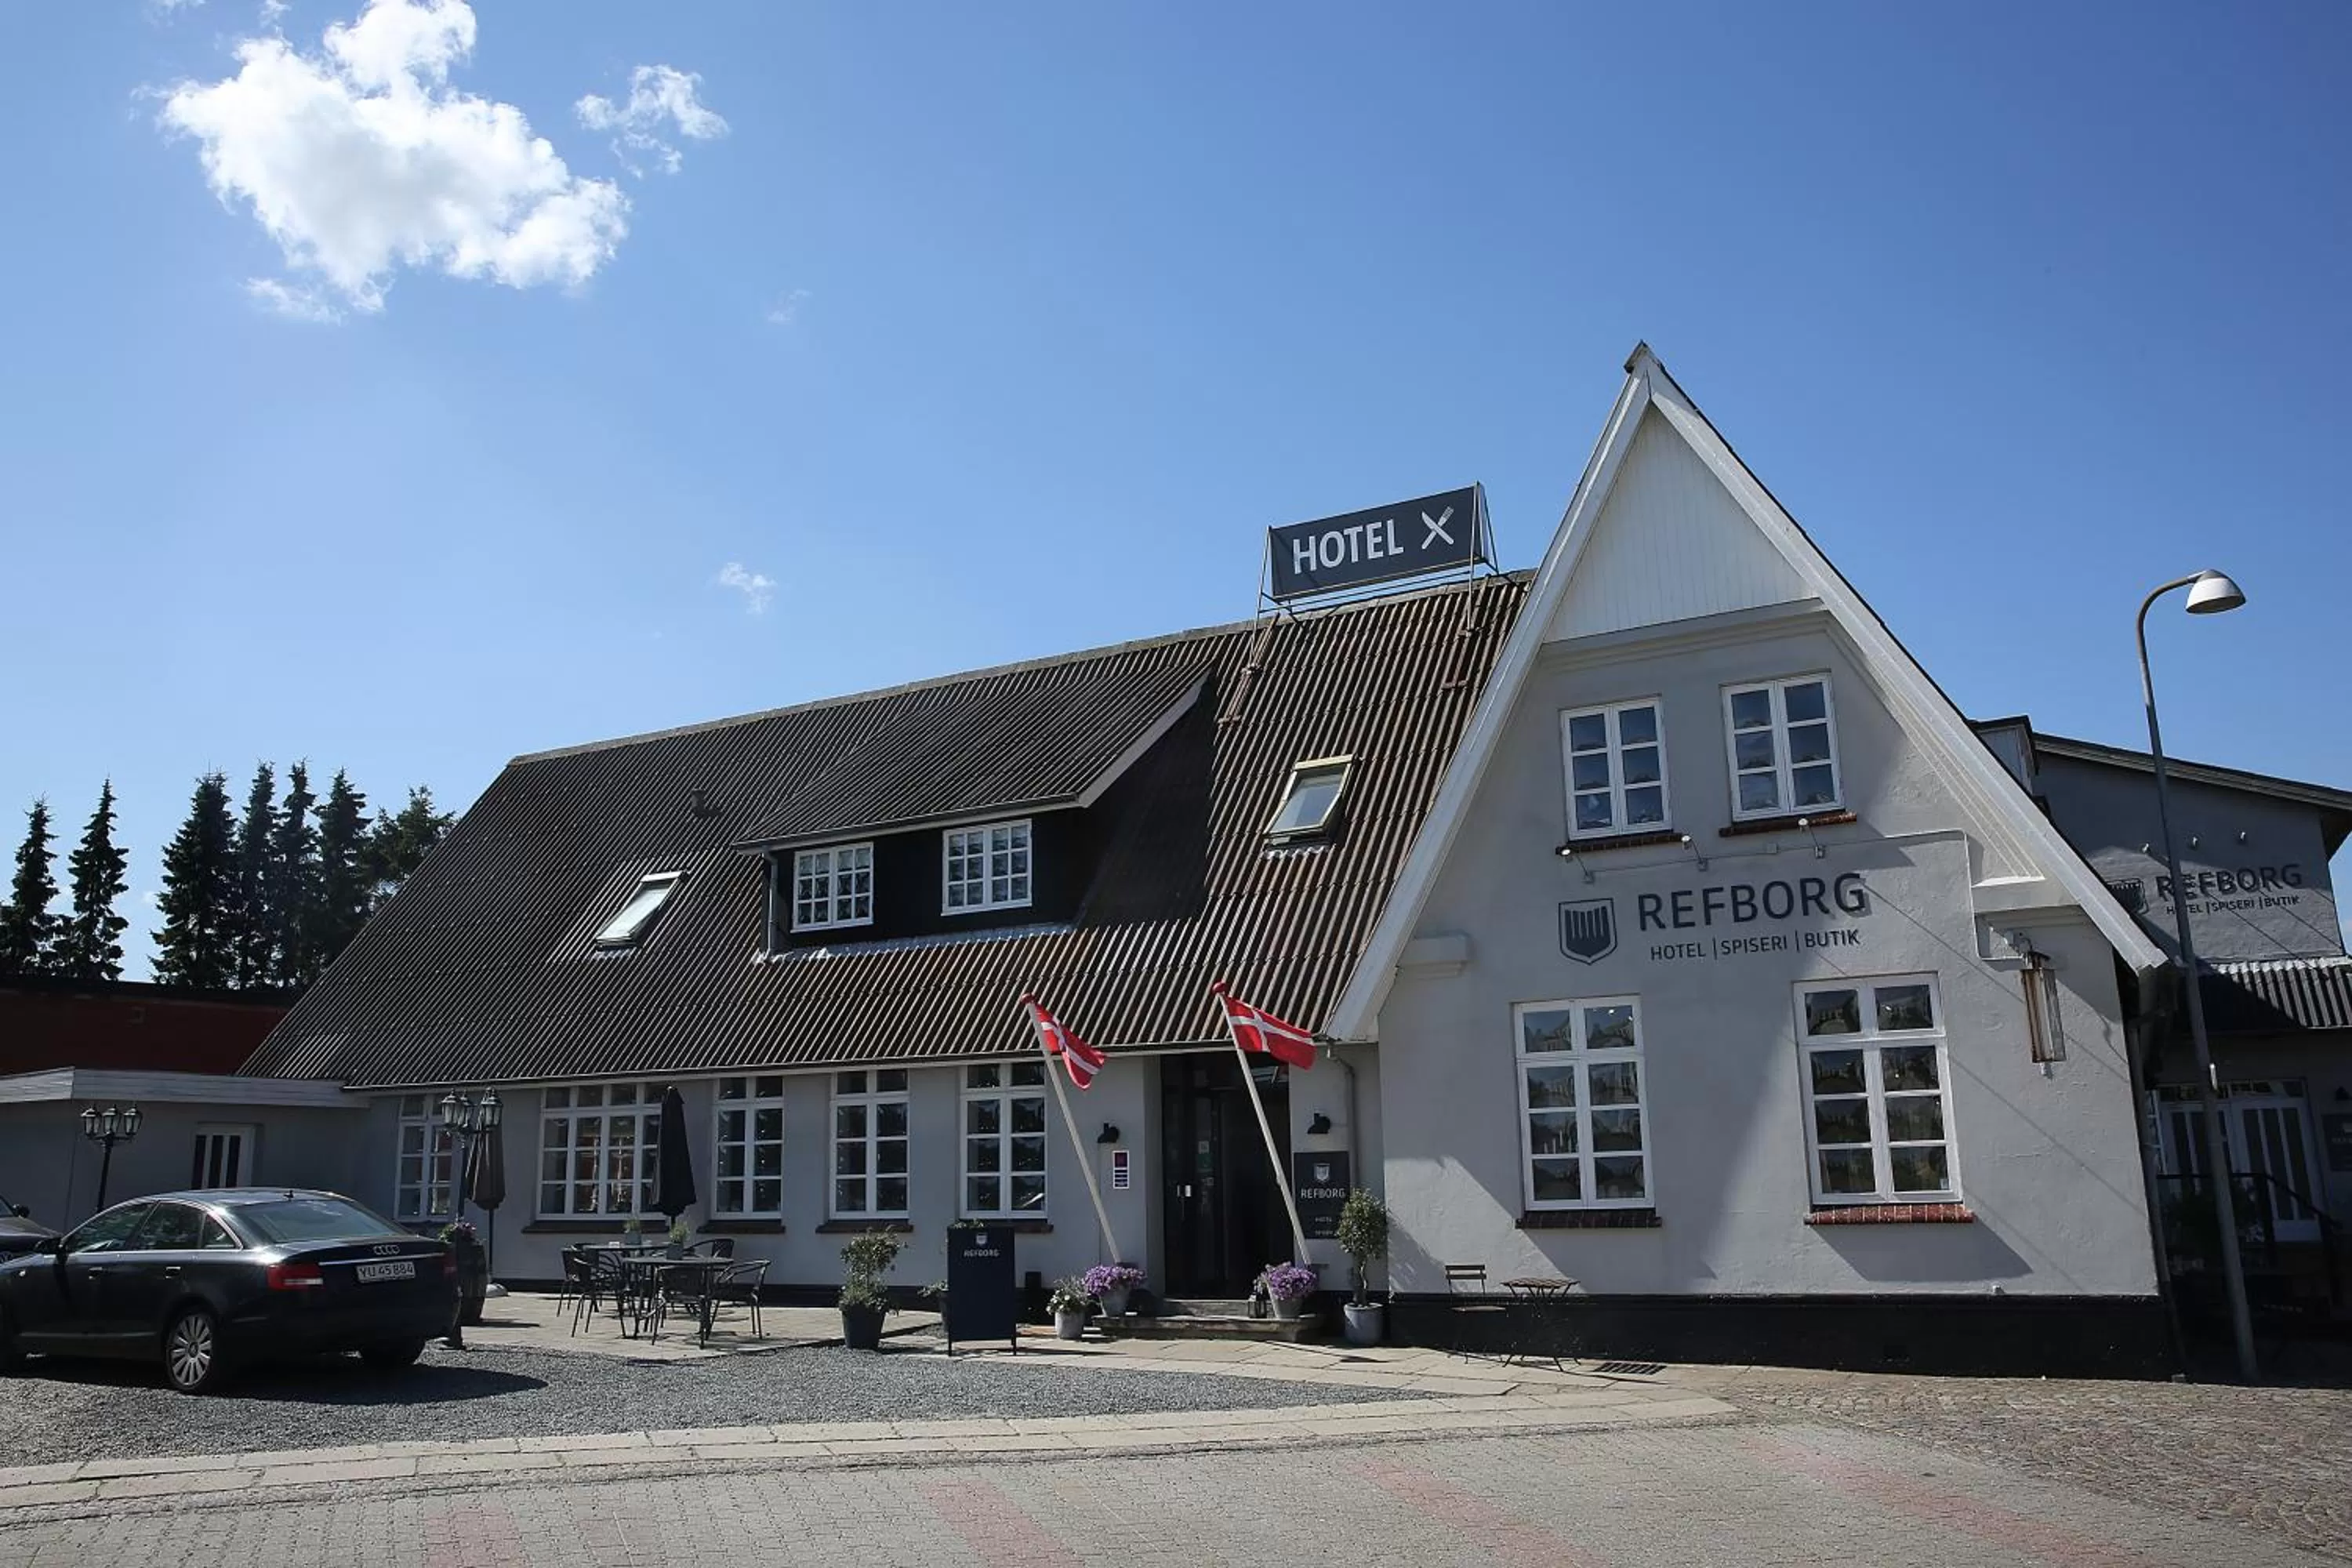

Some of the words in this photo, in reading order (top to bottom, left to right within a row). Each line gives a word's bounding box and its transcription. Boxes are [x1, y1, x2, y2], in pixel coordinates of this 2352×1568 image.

[1294, 518, 1404, 575] HOTEL
[2156, 864, 2302, 901] REFBORG
[1639, 873, 1866, 931] REFBORG
[2166, 905, 2203, 915] HEL
[2212, 899, 2256, 912] SPISERI
[2266, 895, 2299, 907] BUTIK
[1651, 943, 1706, 960] HOTEL
[1721, 936, 1788, 955] SPISERI
[1806, 929, 1860, 948] BUTIK
[1301, 1189, 1345, 1199] REFBORG
